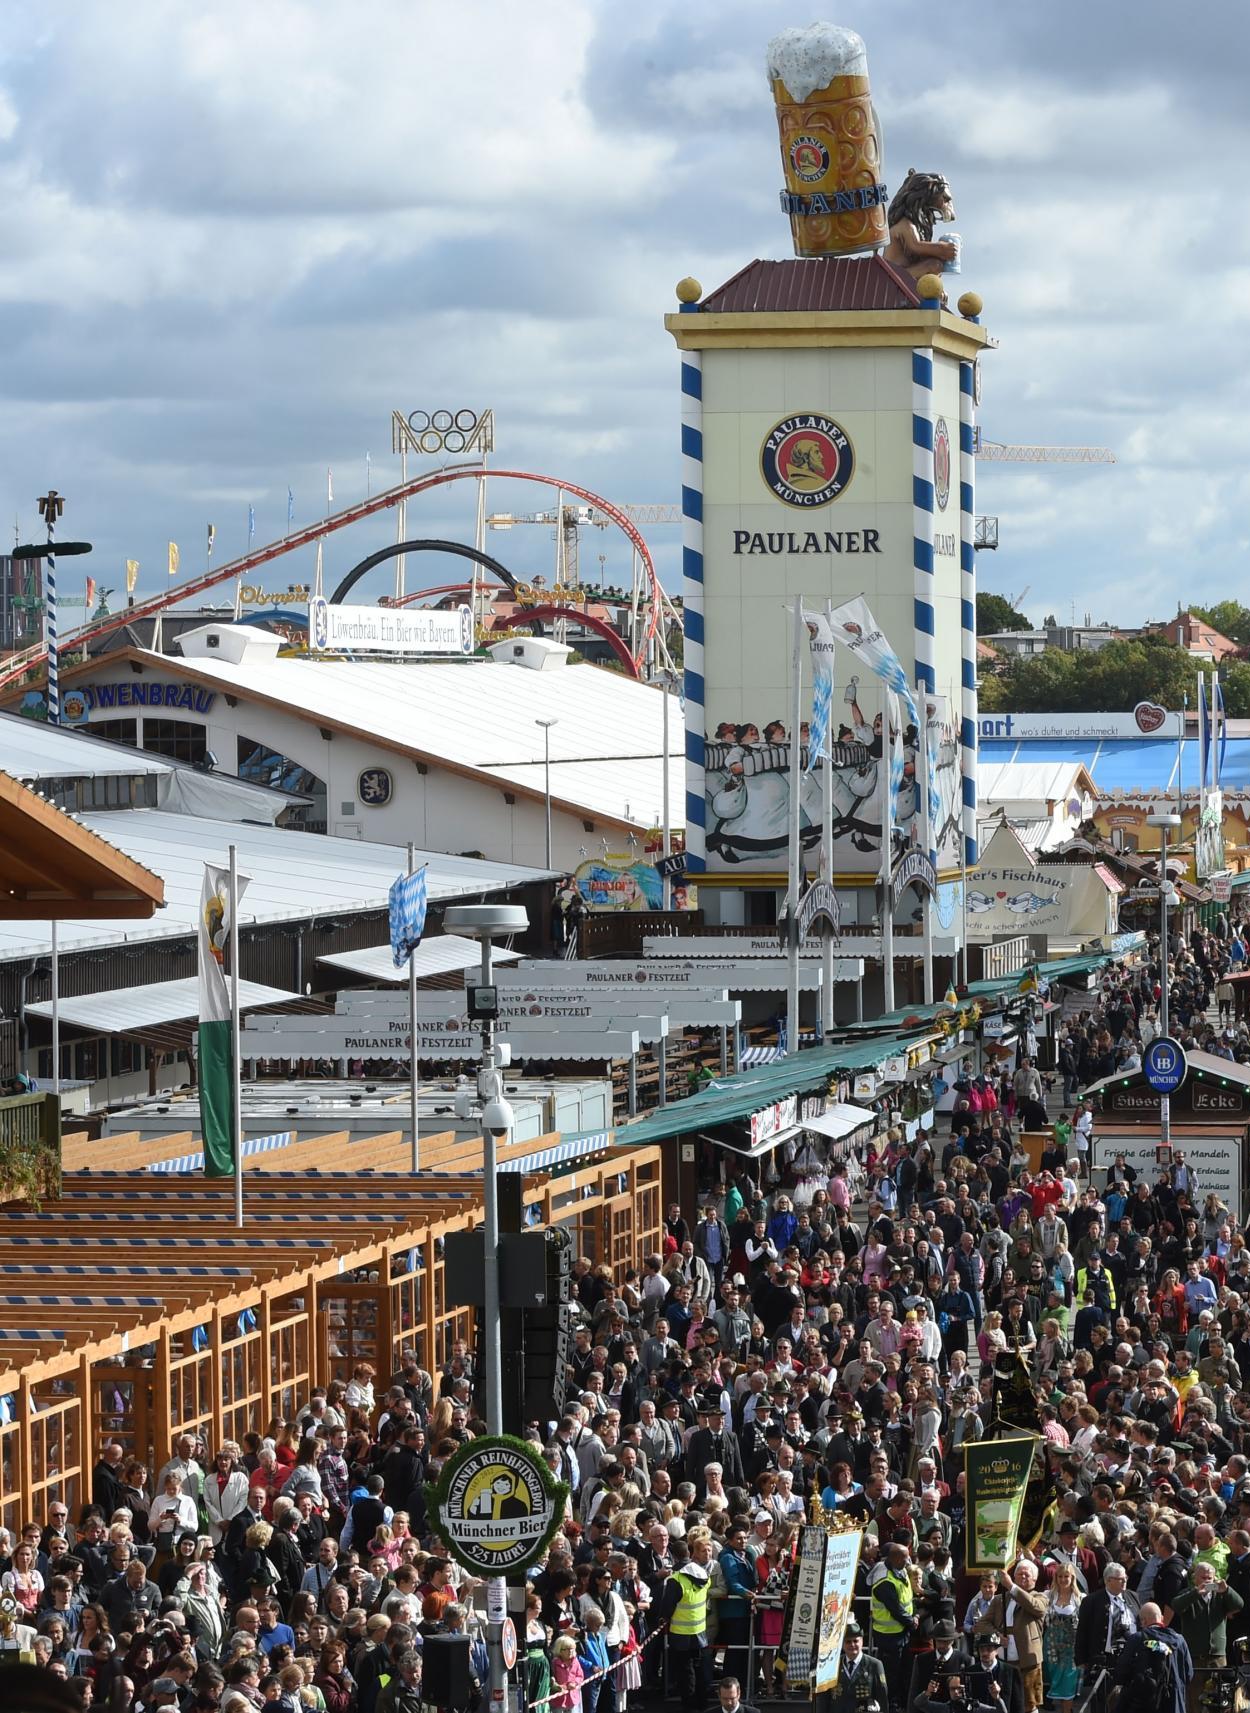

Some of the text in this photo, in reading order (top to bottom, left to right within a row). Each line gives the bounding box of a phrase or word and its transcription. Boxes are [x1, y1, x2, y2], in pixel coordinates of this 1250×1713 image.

[766, 416, 848, 450] PAULANER
[773, 481, 842, 505] MÜNCHEN
[733, 529, 882, 555] PAULANER
[240, 584, 309, 605] Olympia
[381, 617, 394, 641] Ein
[396, 617, 412, 643] Bier
[414, 618, 426, 643] wie
[429, 619, 457, 649] Bayern.
[1041, 726, 1063, 736] duftet
[1065, 727, 1080, 736] und
[1082, 727, 1119, 736] schmeckt
[1002, 869, 1067, 889] Fischhaus
[586, 973, 691, 983] PAULANER FESTZELT
[544, 1006, 592, 1016] FESTZELT
[388, 1021, 443, 1032] PAUANER
[344, 1037, 473, 1048] PAULANER FESTZELT
[1156, 1058, 1171, 1069] HB
[1149, 1075, 1179, 1084] MÜNCHEN
[1117, 1094, 1235, 1108] Süsse Ecke
[1104, 1149, 1135, 1158] Frische
[1190, 1149, 1230, 1158] Mandeln
[1196, 1167, 1230, 1175] Erdnüsse
[450, 1452, 544, 1517] MÜNCHNER REINHEITSGEBOT
[451, 1520, 546, 1538] Münchner Bier
[468, 1542, 527, 1565] 525 JAHRE
